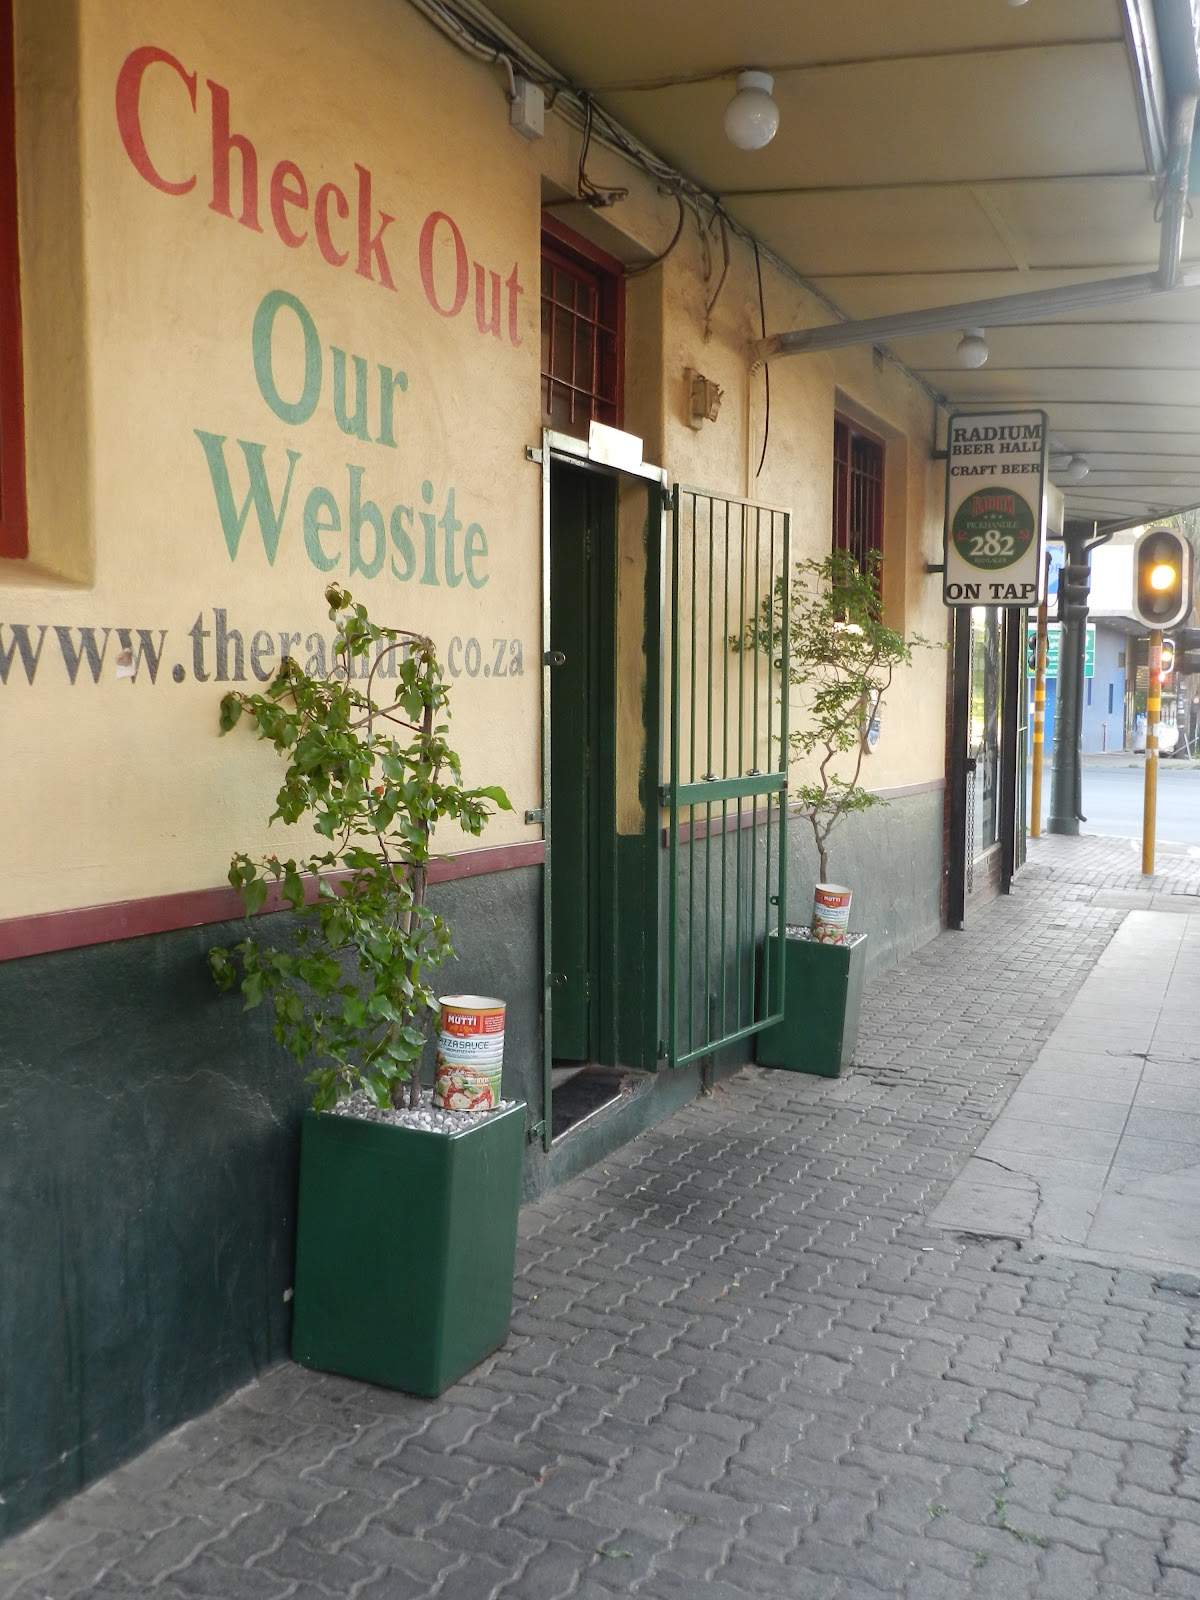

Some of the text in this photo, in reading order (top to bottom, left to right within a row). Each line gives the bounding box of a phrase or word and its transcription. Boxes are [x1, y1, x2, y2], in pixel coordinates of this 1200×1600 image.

[115, 45, 525, 347] Check Out
[251, 289, 408, 448] Our
[953, 425, 1041, 441] RADIUM
[952, 441, 1041, 455] BEER HALL
[951, 463, 1040, 477] CRAFT BEER
[193, 429, 490, 589] Website
[969, 529, 1015, 556] 282
[946, 583, 1036, 600] ON TAP
[0, 607, 525, 686] www.theradu.co.za
[447, 1015, 477, 1026] MUTTI
